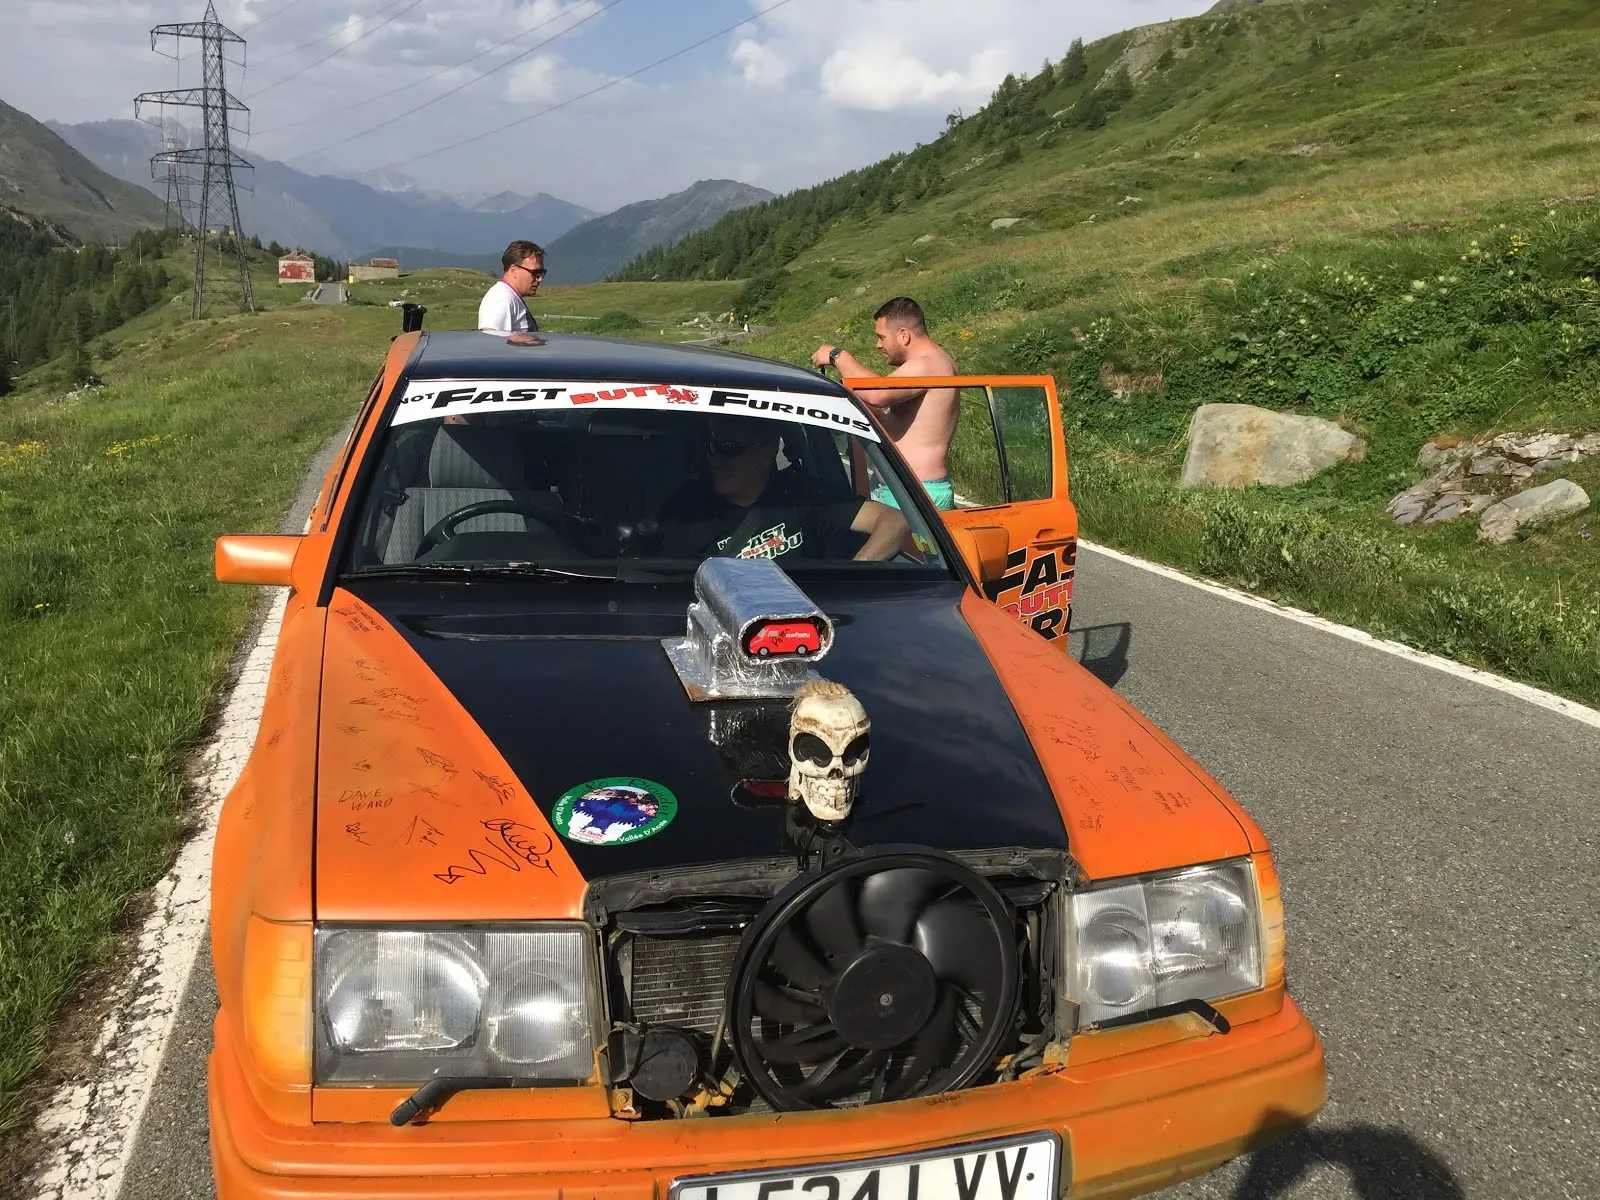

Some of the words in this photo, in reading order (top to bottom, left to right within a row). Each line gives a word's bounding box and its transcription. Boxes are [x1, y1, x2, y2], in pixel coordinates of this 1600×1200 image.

[400, 392, 435, 404] NOT
[430, 386, 567, 409] FAST
[569, 384, 671, 406] BUTT
[708, 390, 872, 433] FURIOUS
[338, 788, 382, 803] DAVE
[351, 797, 393, 811] WARD
